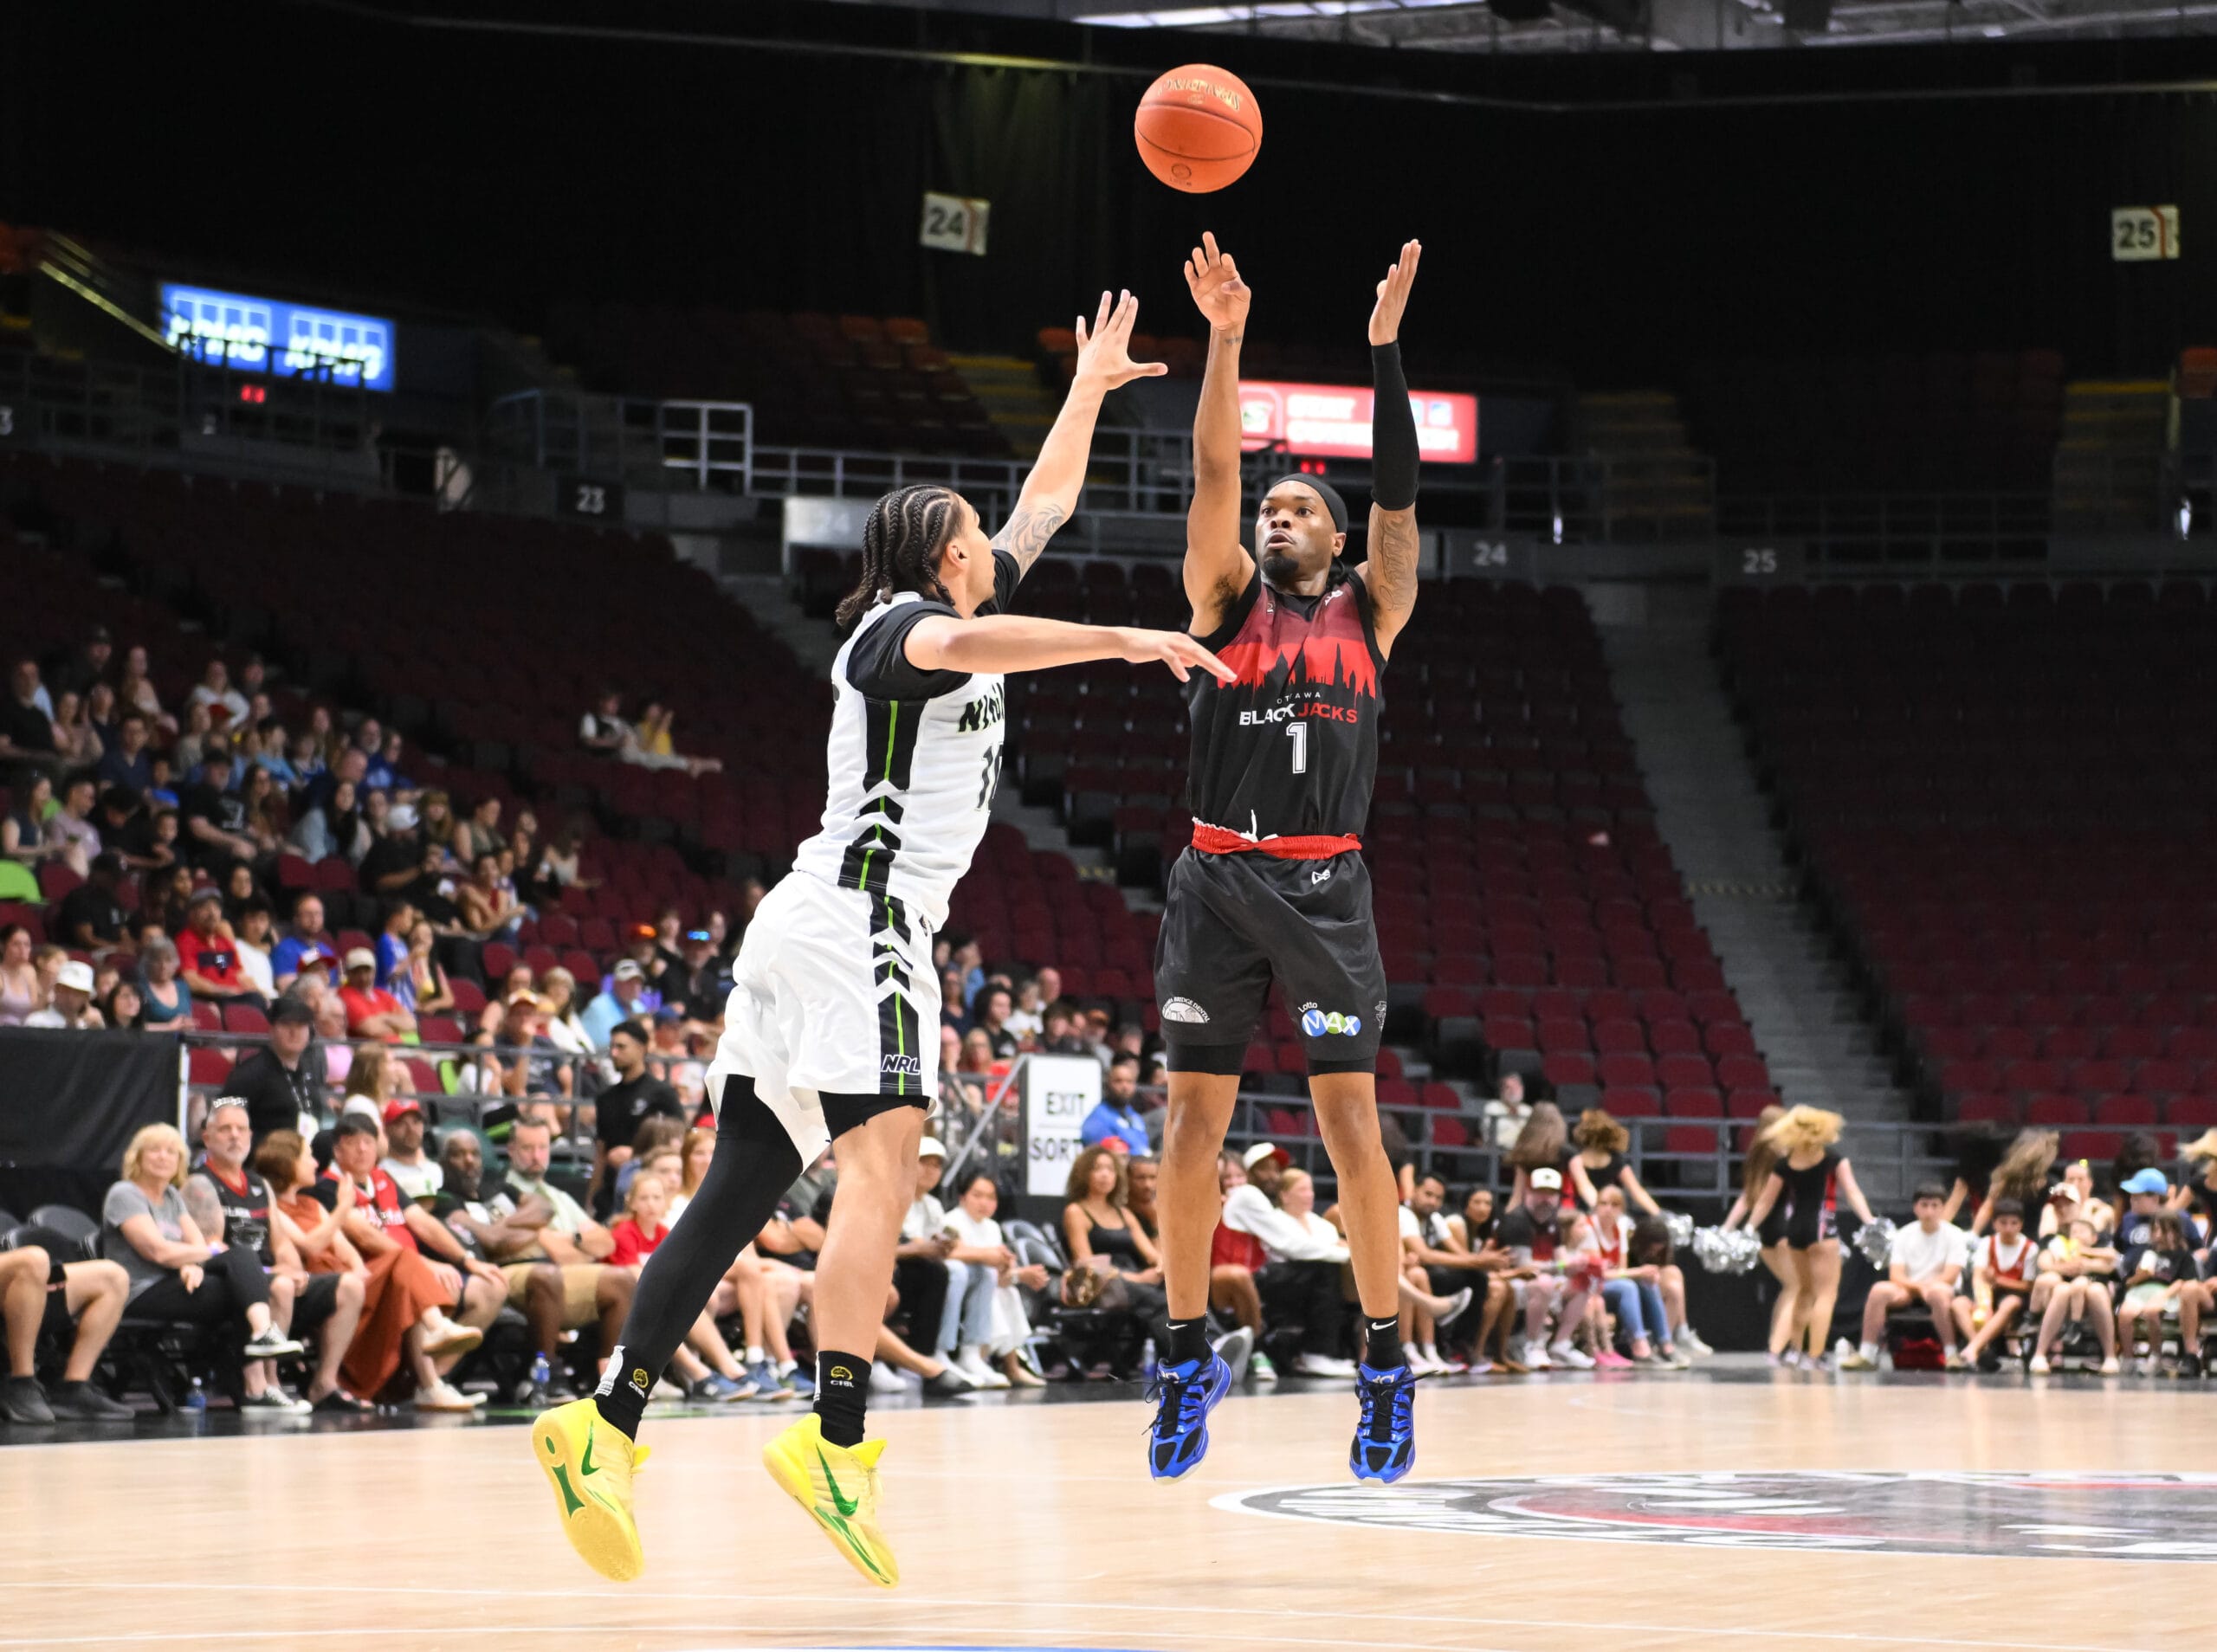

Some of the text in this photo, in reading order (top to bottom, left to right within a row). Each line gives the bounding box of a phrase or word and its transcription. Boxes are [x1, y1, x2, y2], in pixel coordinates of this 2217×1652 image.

[927, 206, 963, 236] 24
[2118, 219, 2156, 249] 25
[576, 485, 605, 514] 23
[1473, 540, 1508, 567] 24
[1742, 548, 1777, 574] 25
[1286, 721, 1307, 774] 1
[1193, 1002, 1211, 1023] DENTAL
[1297, 1002, 1317, 1013] Lotto
[1301, 1010, 1361, 1036] MAX
[880, 1054, 921, 1075] NRL
[1045, 1092, 1085, 1116] EXIT
